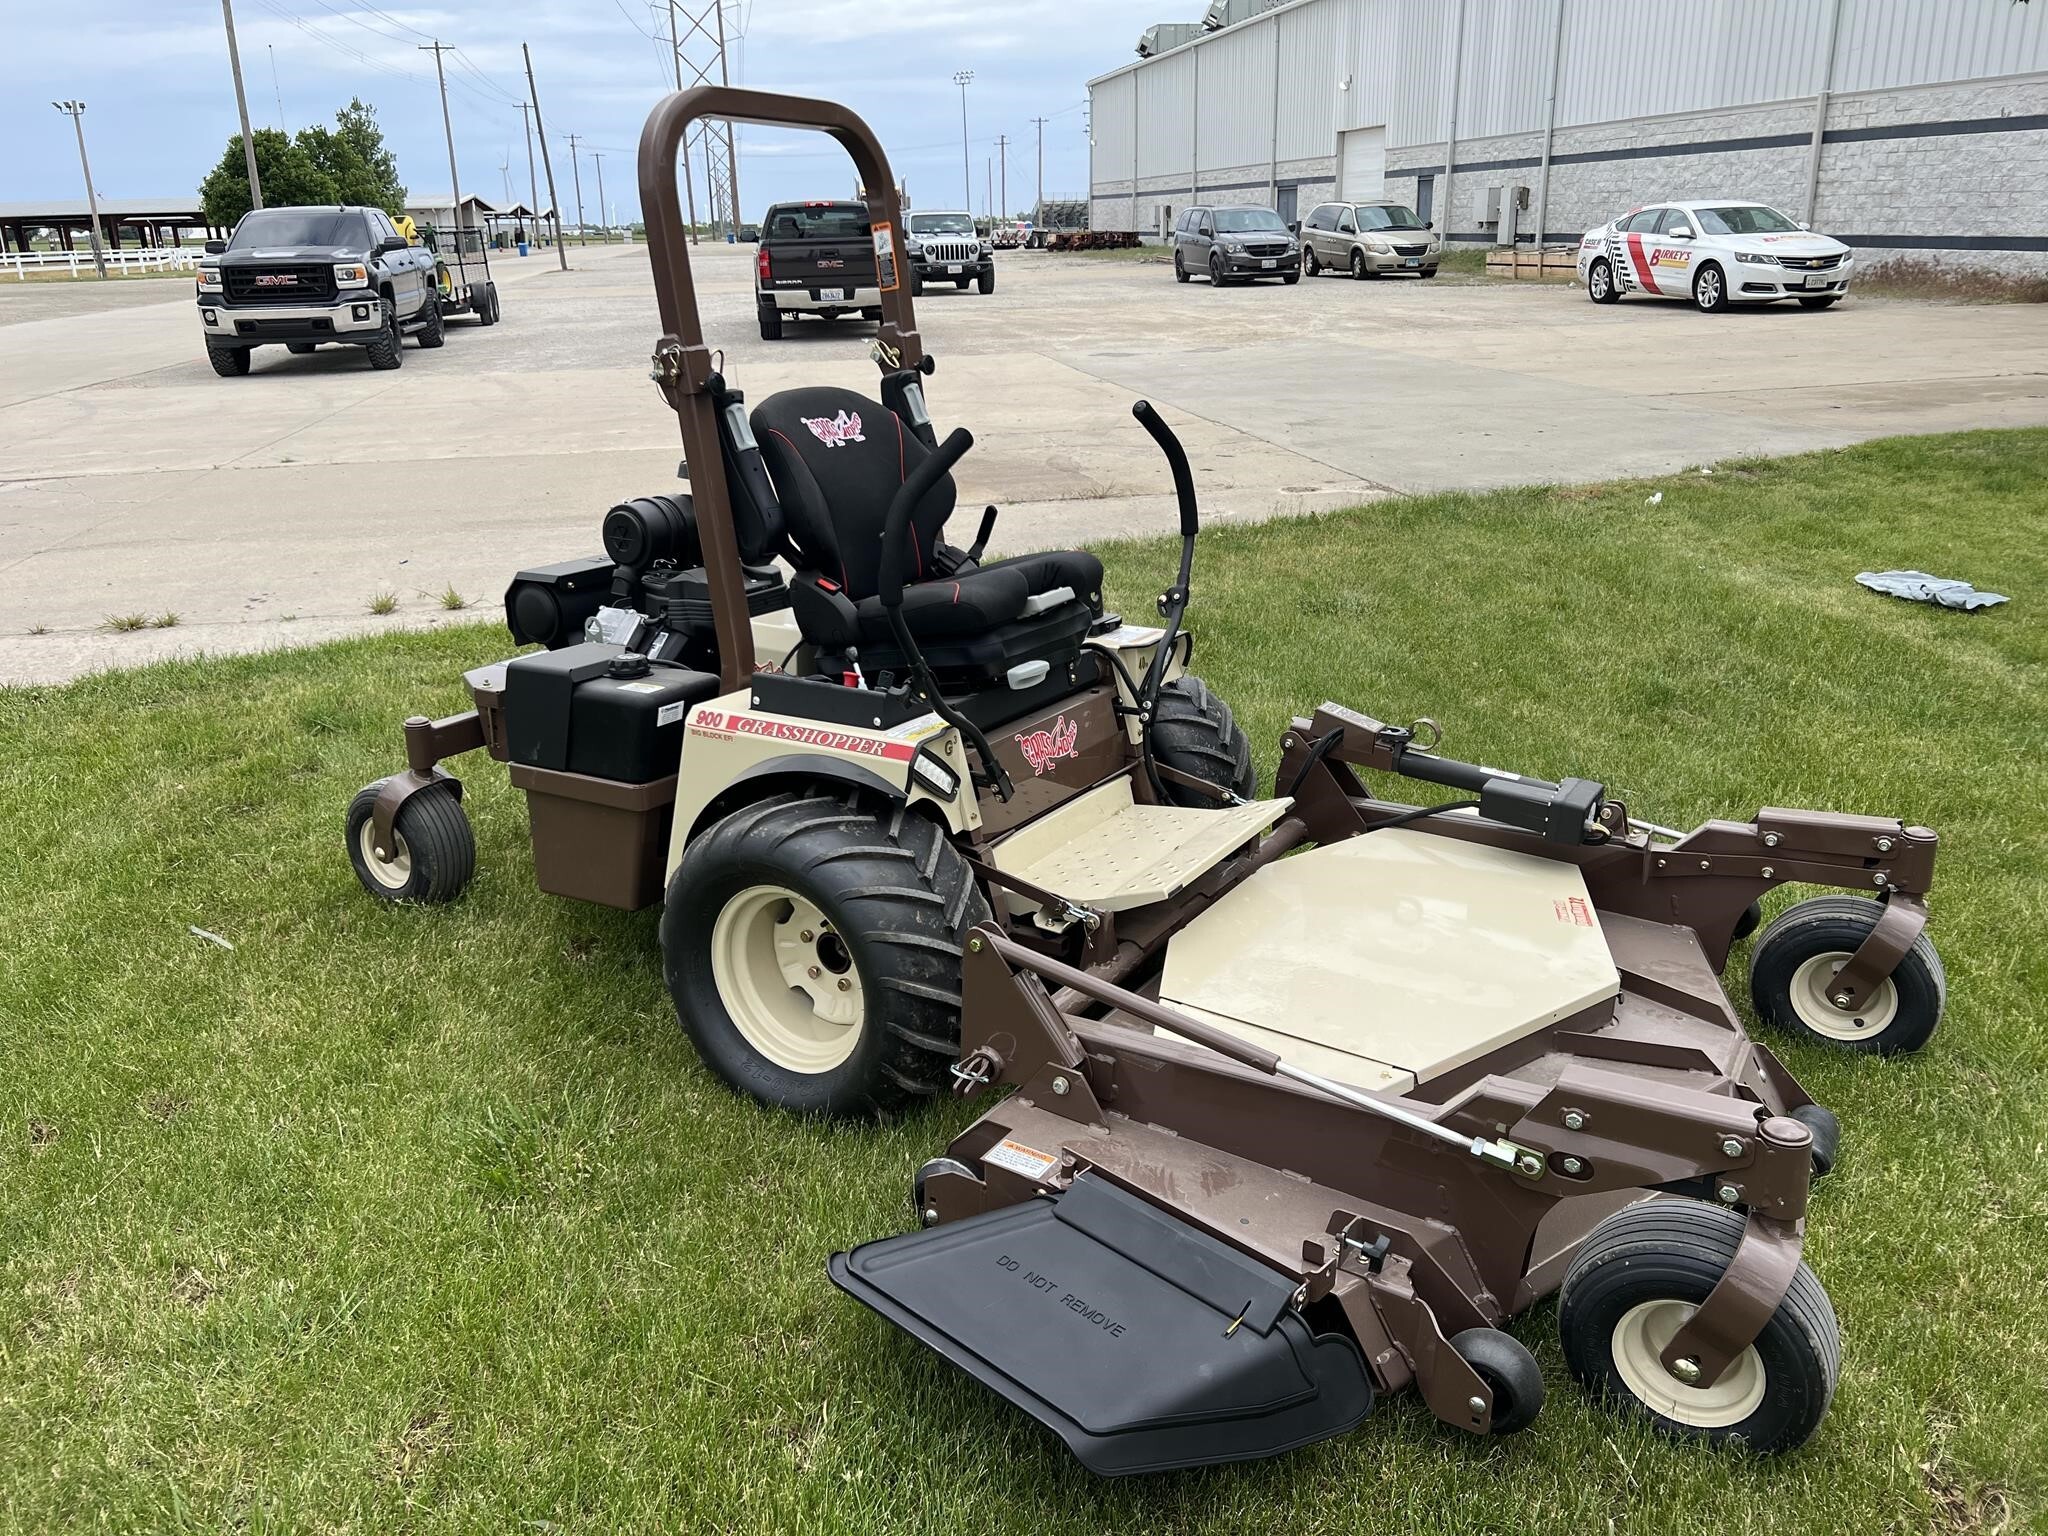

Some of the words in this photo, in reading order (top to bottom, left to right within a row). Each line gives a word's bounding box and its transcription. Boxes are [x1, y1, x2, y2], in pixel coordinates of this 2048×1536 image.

[817, 260, 844, 269] GMC
[1649, 248, 1692, 267] BIRKEY'S
[255, 274, 298, 286] GMC
[691, 728, 701, 737] BIG
[702, 730, 722, 741] BLOCK
[696, 710, 723, 729] 900
[737, 718, 887, 757] GRASSHOPPER
[995, 1254, 1021, 1273] DO
[1023, 1271, 1059, 1294] NOT
[1060, 1293, 1127, 1338] REMOVE
